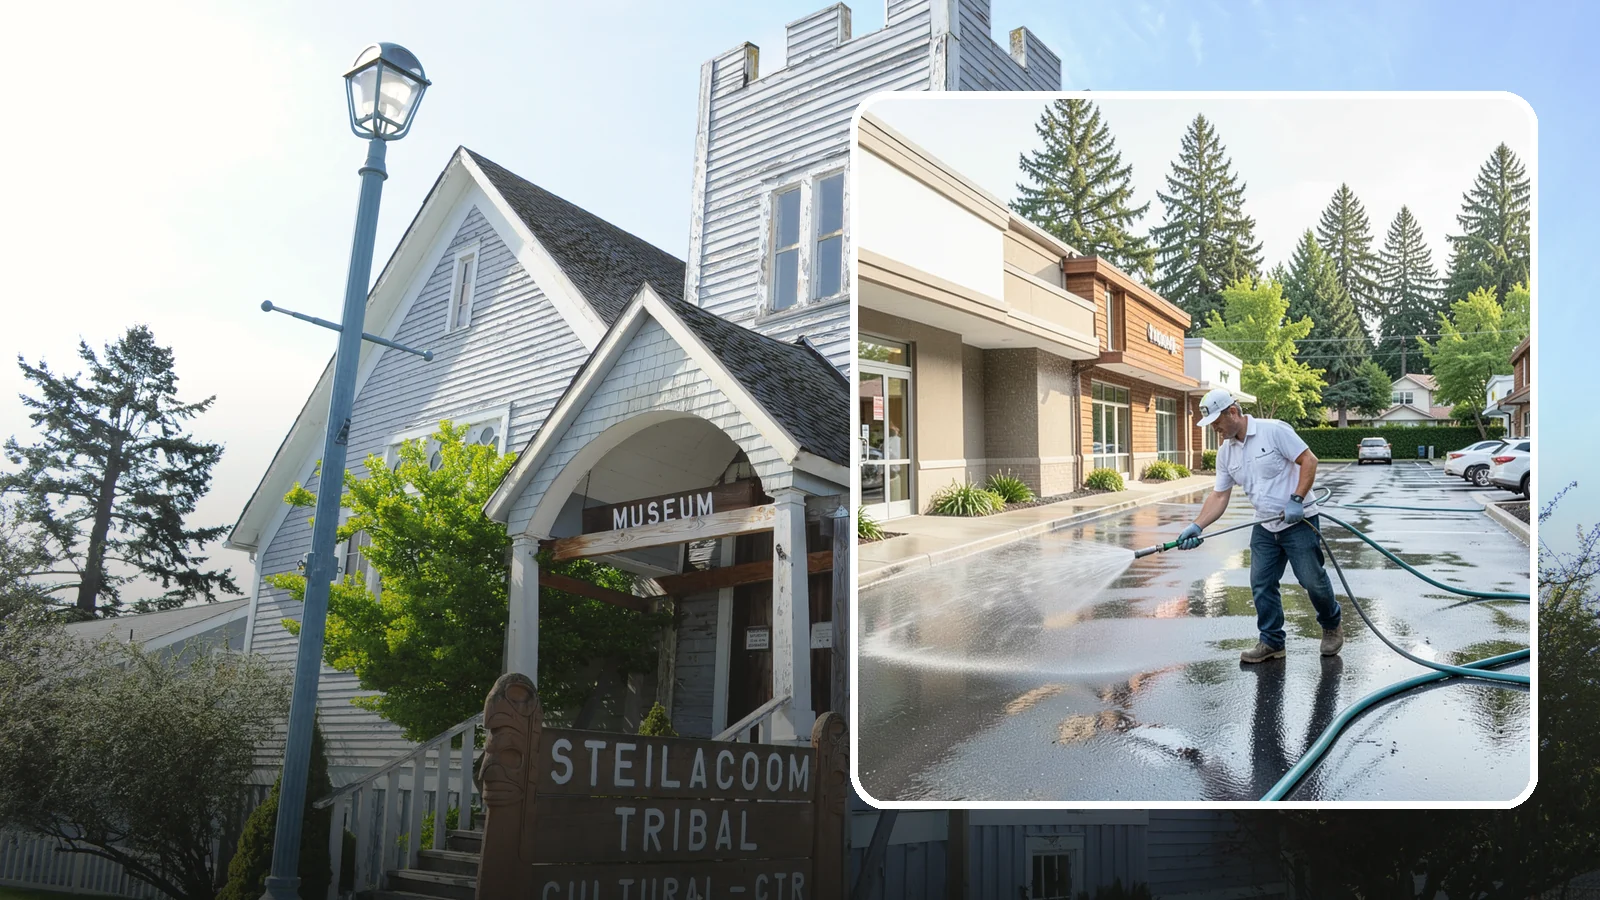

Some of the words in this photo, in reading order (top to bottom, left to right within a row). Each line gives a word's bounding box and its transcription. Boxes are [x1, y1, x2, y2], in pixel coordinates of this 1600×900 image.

[612, 491, 714, 530] MUSEUM
[550, 738, 810, 793] STEILACOOM
[615, 807, 757, 852] TRIBAL
